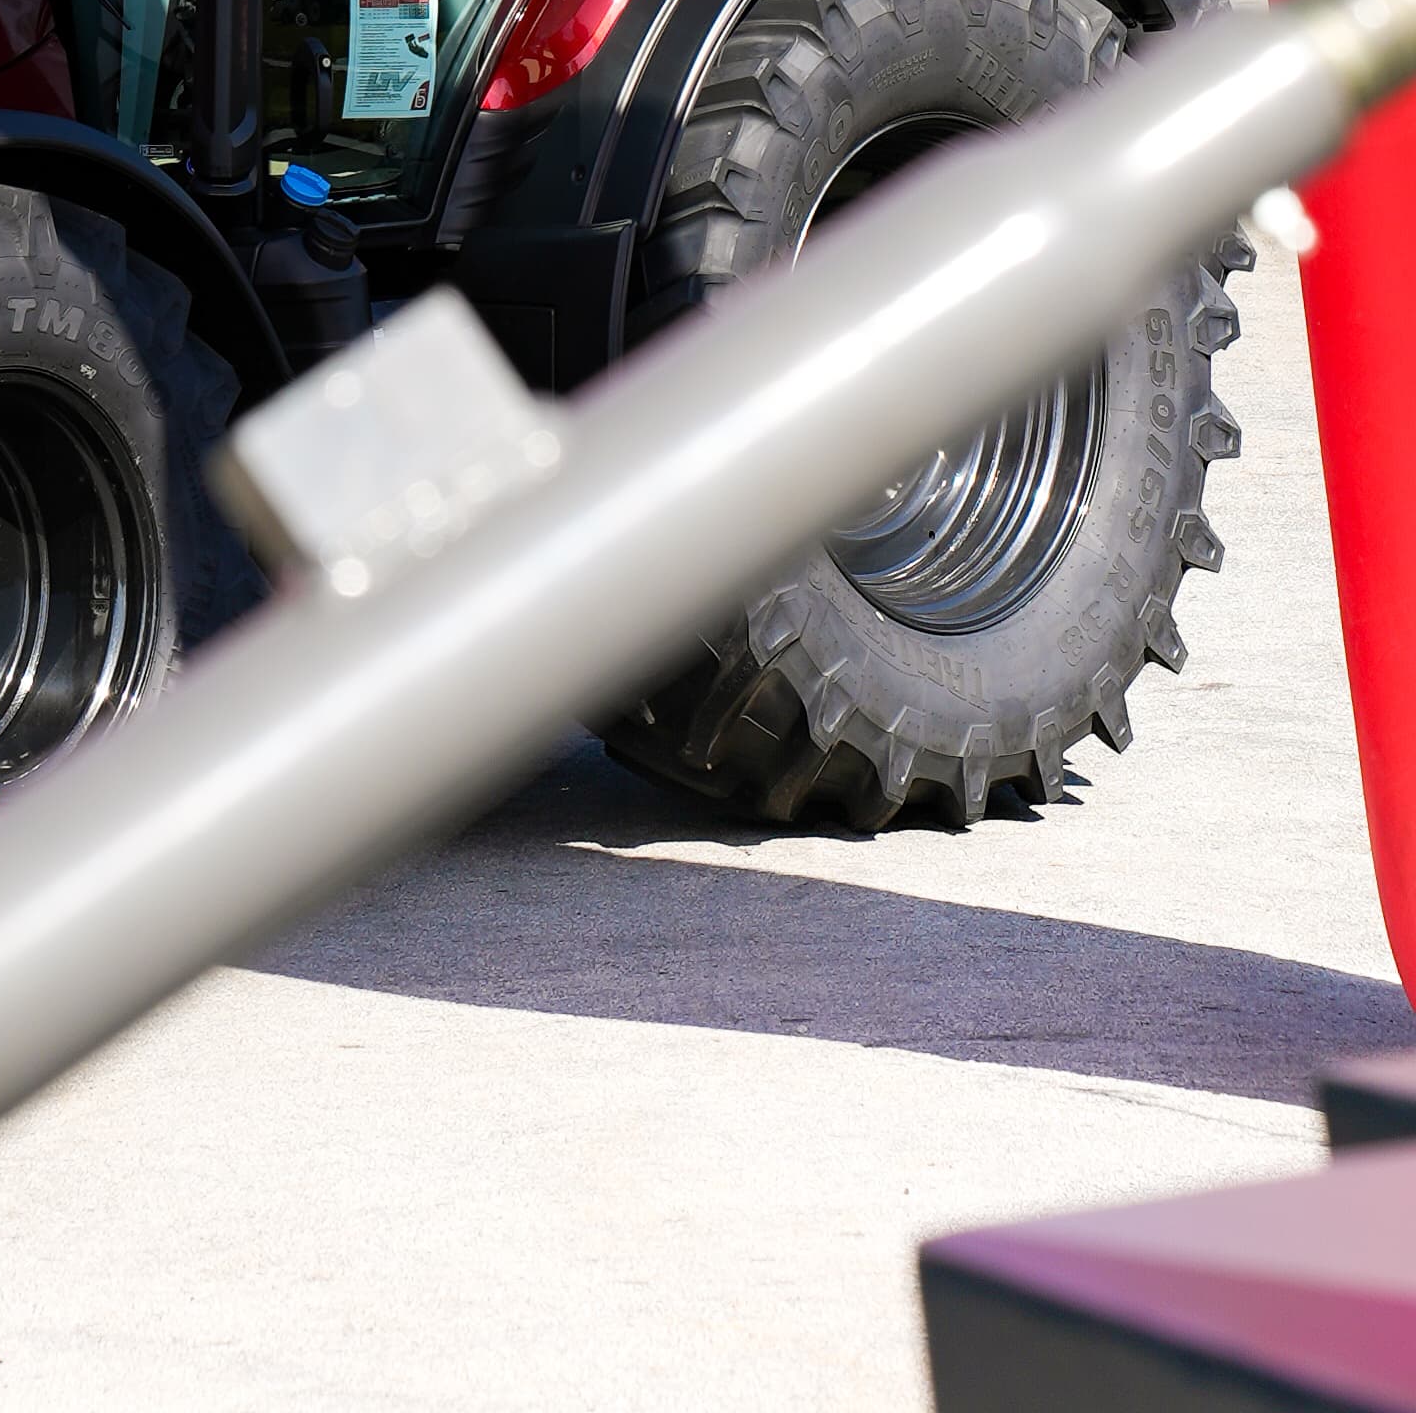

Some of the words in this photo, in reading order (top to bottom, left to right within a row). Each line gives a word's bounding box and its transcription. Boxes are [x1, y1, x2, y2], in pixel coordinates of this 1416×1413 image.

[7, 295, 169, 419] TM800
[1126, 307, 1177, 549] 650/65
[1103, 552, 1137, 603] R
[1057, 599, 1114, 667] 38
